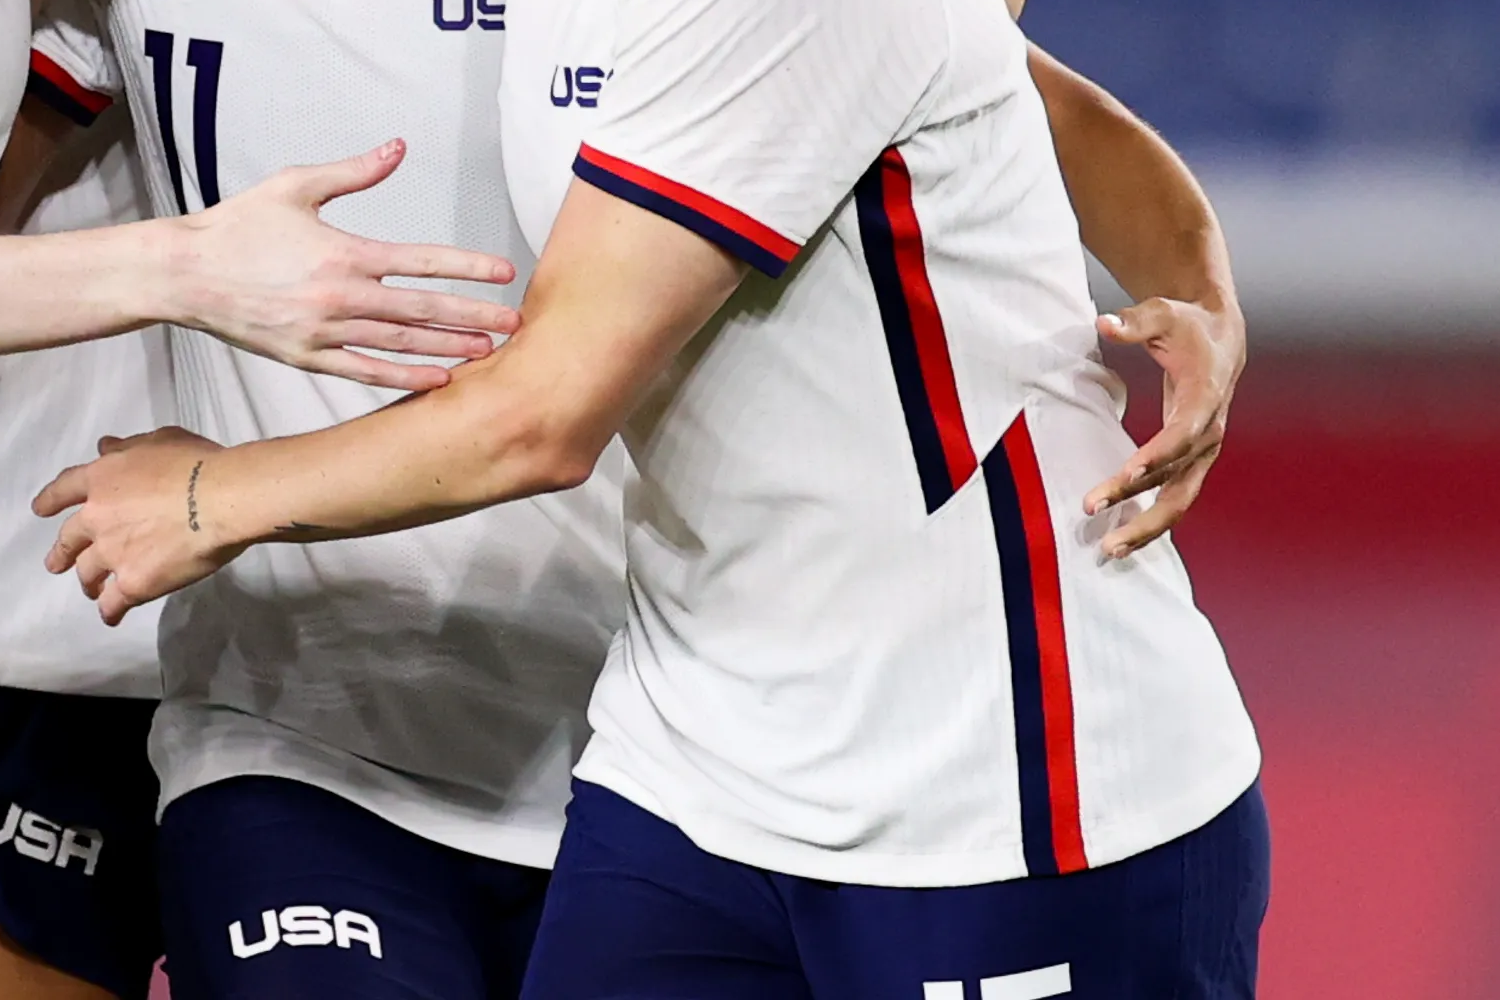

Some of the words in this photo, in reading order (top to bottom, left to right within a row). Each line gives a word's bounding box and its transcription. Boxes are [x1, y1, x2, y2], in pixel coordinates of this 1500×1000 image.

[550, 64, 614, 108] US
[145, 29, 224, 216] 11
[228, 905, 383, 960] USA
